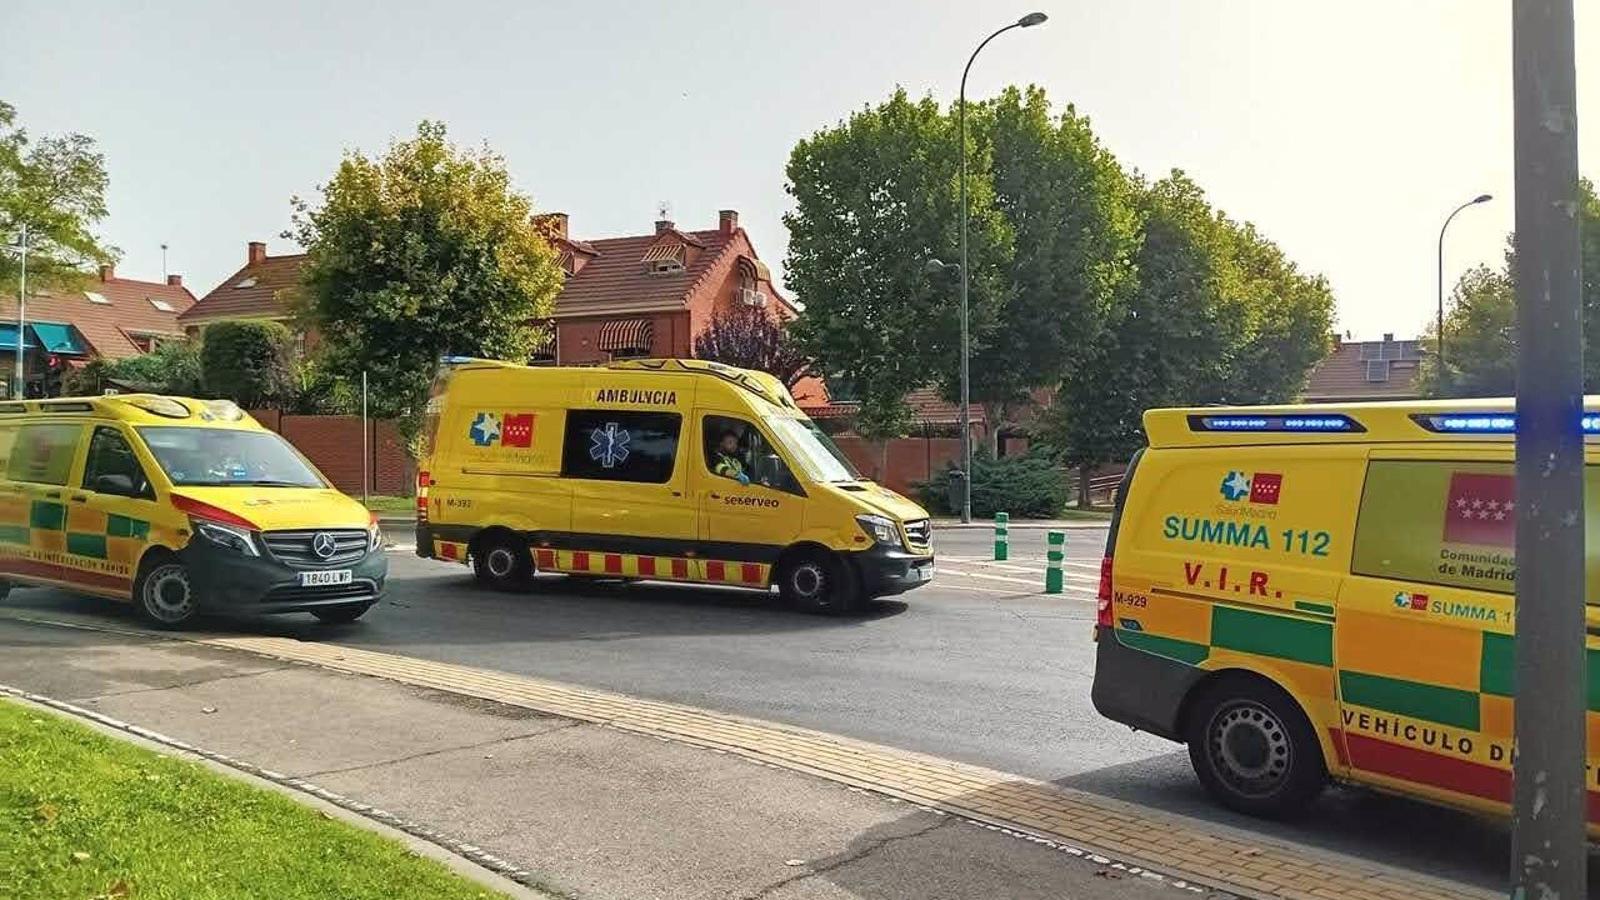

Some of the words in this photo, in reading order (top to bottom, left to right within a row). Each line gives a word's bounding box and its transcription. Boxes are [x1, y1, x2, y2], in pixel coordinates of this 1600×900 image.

[1163, 515, 1270, 550] SUMMA
[1282, 529, 1331, 557] 112
[1184, 561, 1282, 598] V.I.R.
[1438, 562, 1457, 575] de
[1114, 591, 1148, 608] M-929
[1431, 600, 1497, 621] SUMMA
[1342, 708, 1473, 755] VEHÍCULO
